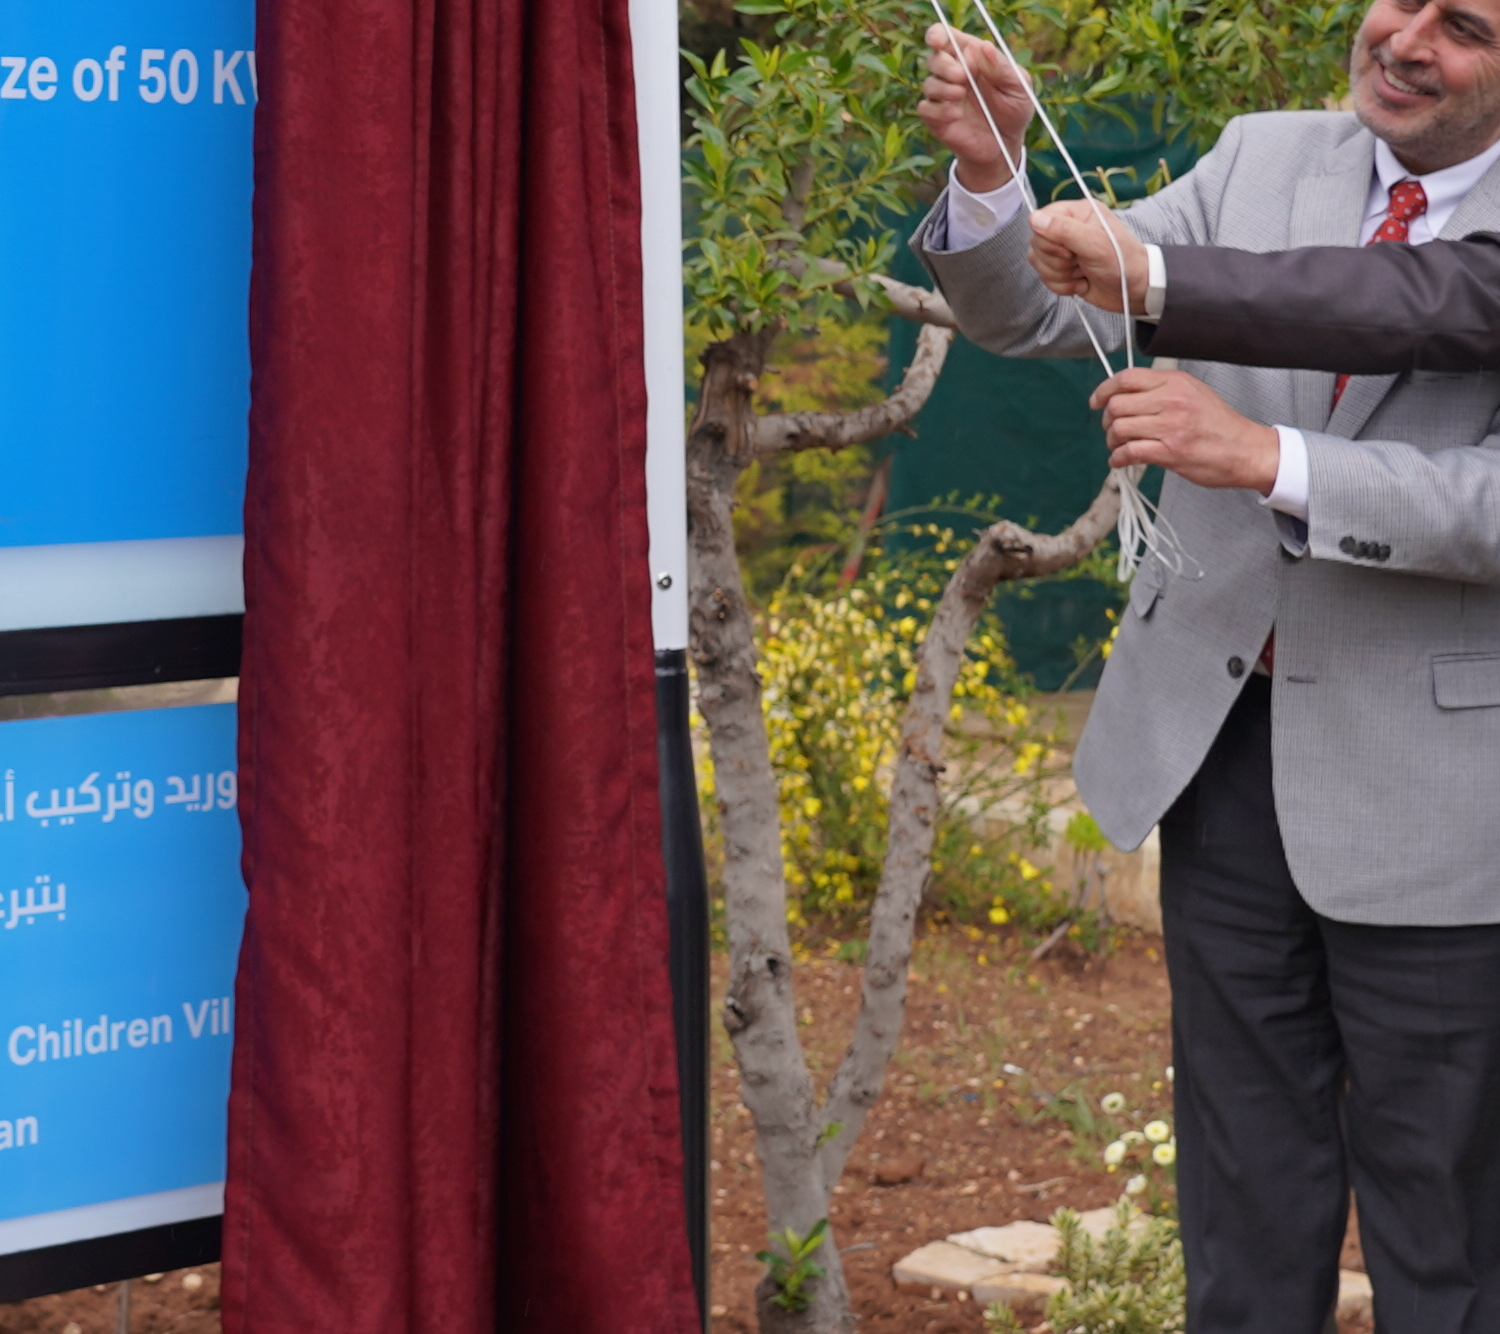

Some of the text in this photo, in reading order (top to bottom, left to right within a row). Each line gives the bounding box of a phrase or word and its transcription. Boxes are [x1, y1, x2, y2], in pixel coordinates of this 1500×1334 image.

[71, 44, 128, 103] of
[137, 48, 200, 105] 50
[212, 48, 259, 105] K
[24, 770, 155, 826] وتركيب
[163, 770, 238, 812] وريد
[7, 1012, 173, 1067] Children
[182, 996, 230, 1039] Vil
